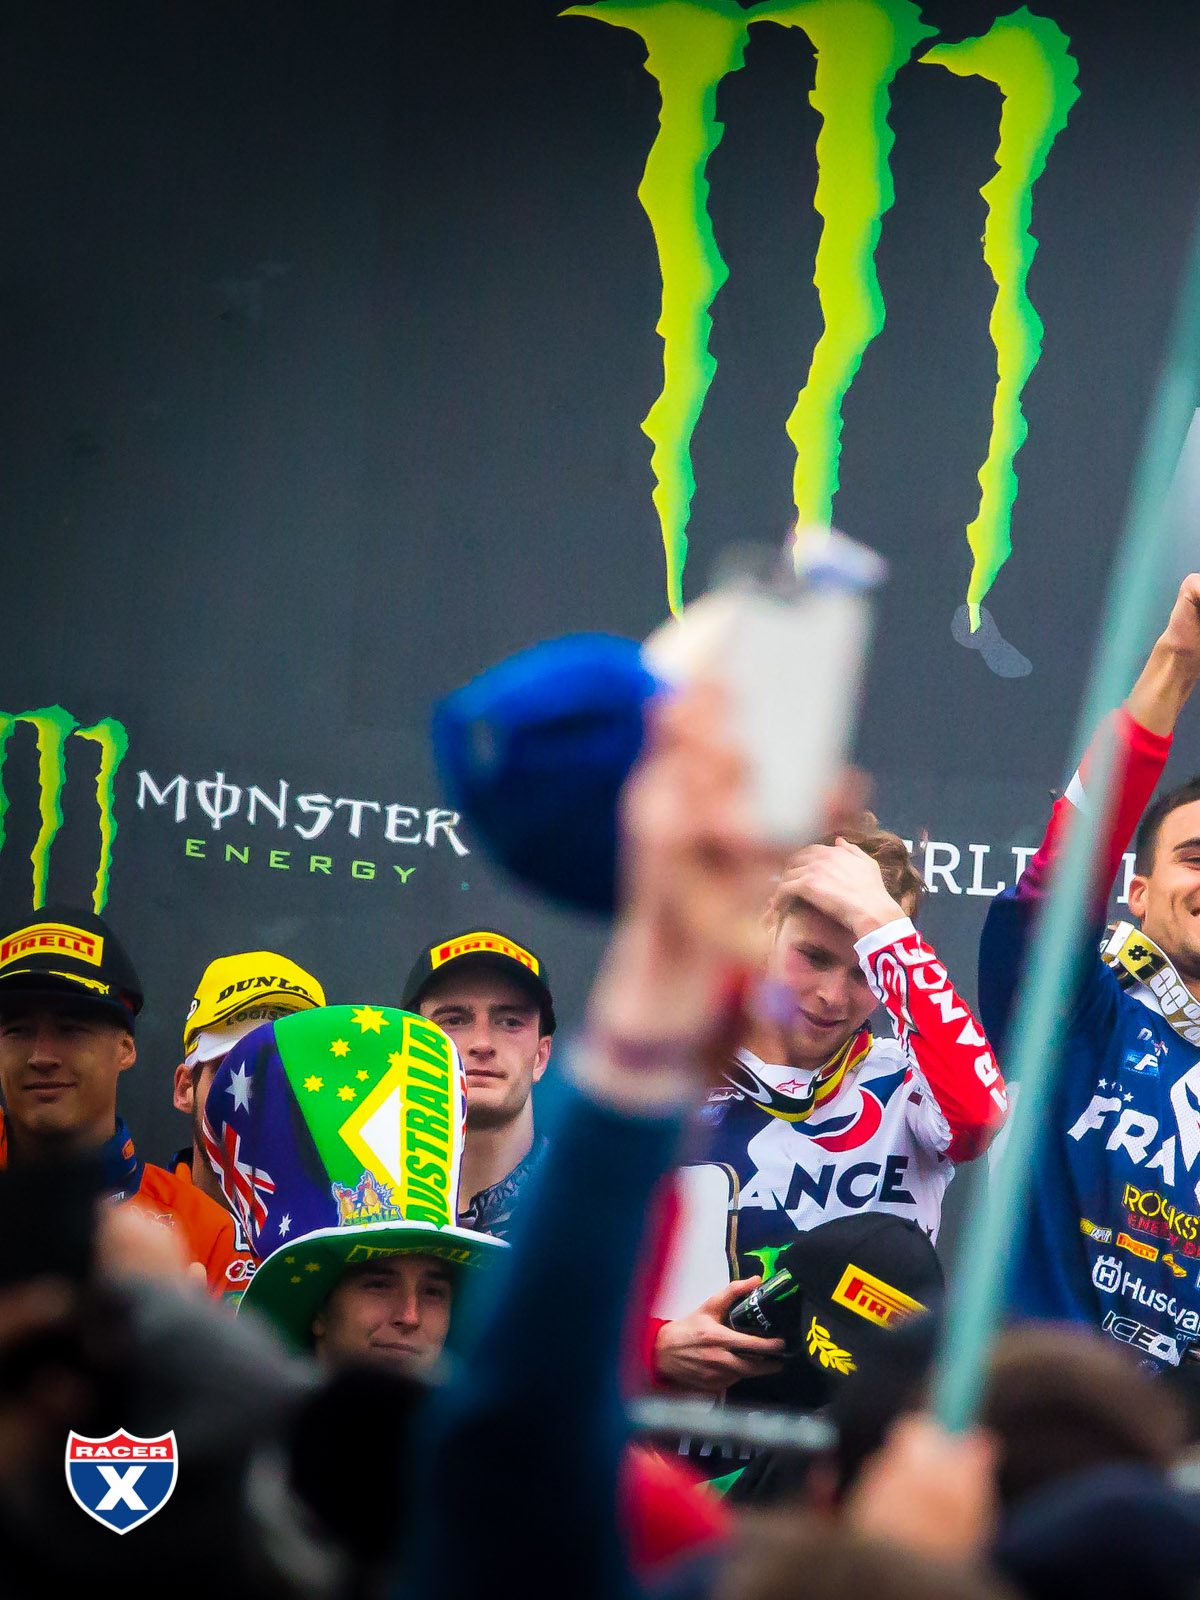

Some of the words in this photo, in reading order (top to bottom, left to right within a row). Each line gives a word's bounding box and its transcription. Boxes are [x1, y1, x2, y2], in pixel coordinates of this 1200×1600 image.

[136, 769, 470, 857] MONSTER
[185, 838, 417, 884] ENERGY
[1, 928, 96, 962] PIRELLI
[439, 935, 533, 969] PIRELLI
[405, 1021, 451, 1230] AUSTRALIA
[728, 1155, 917, 1211] ANCE
